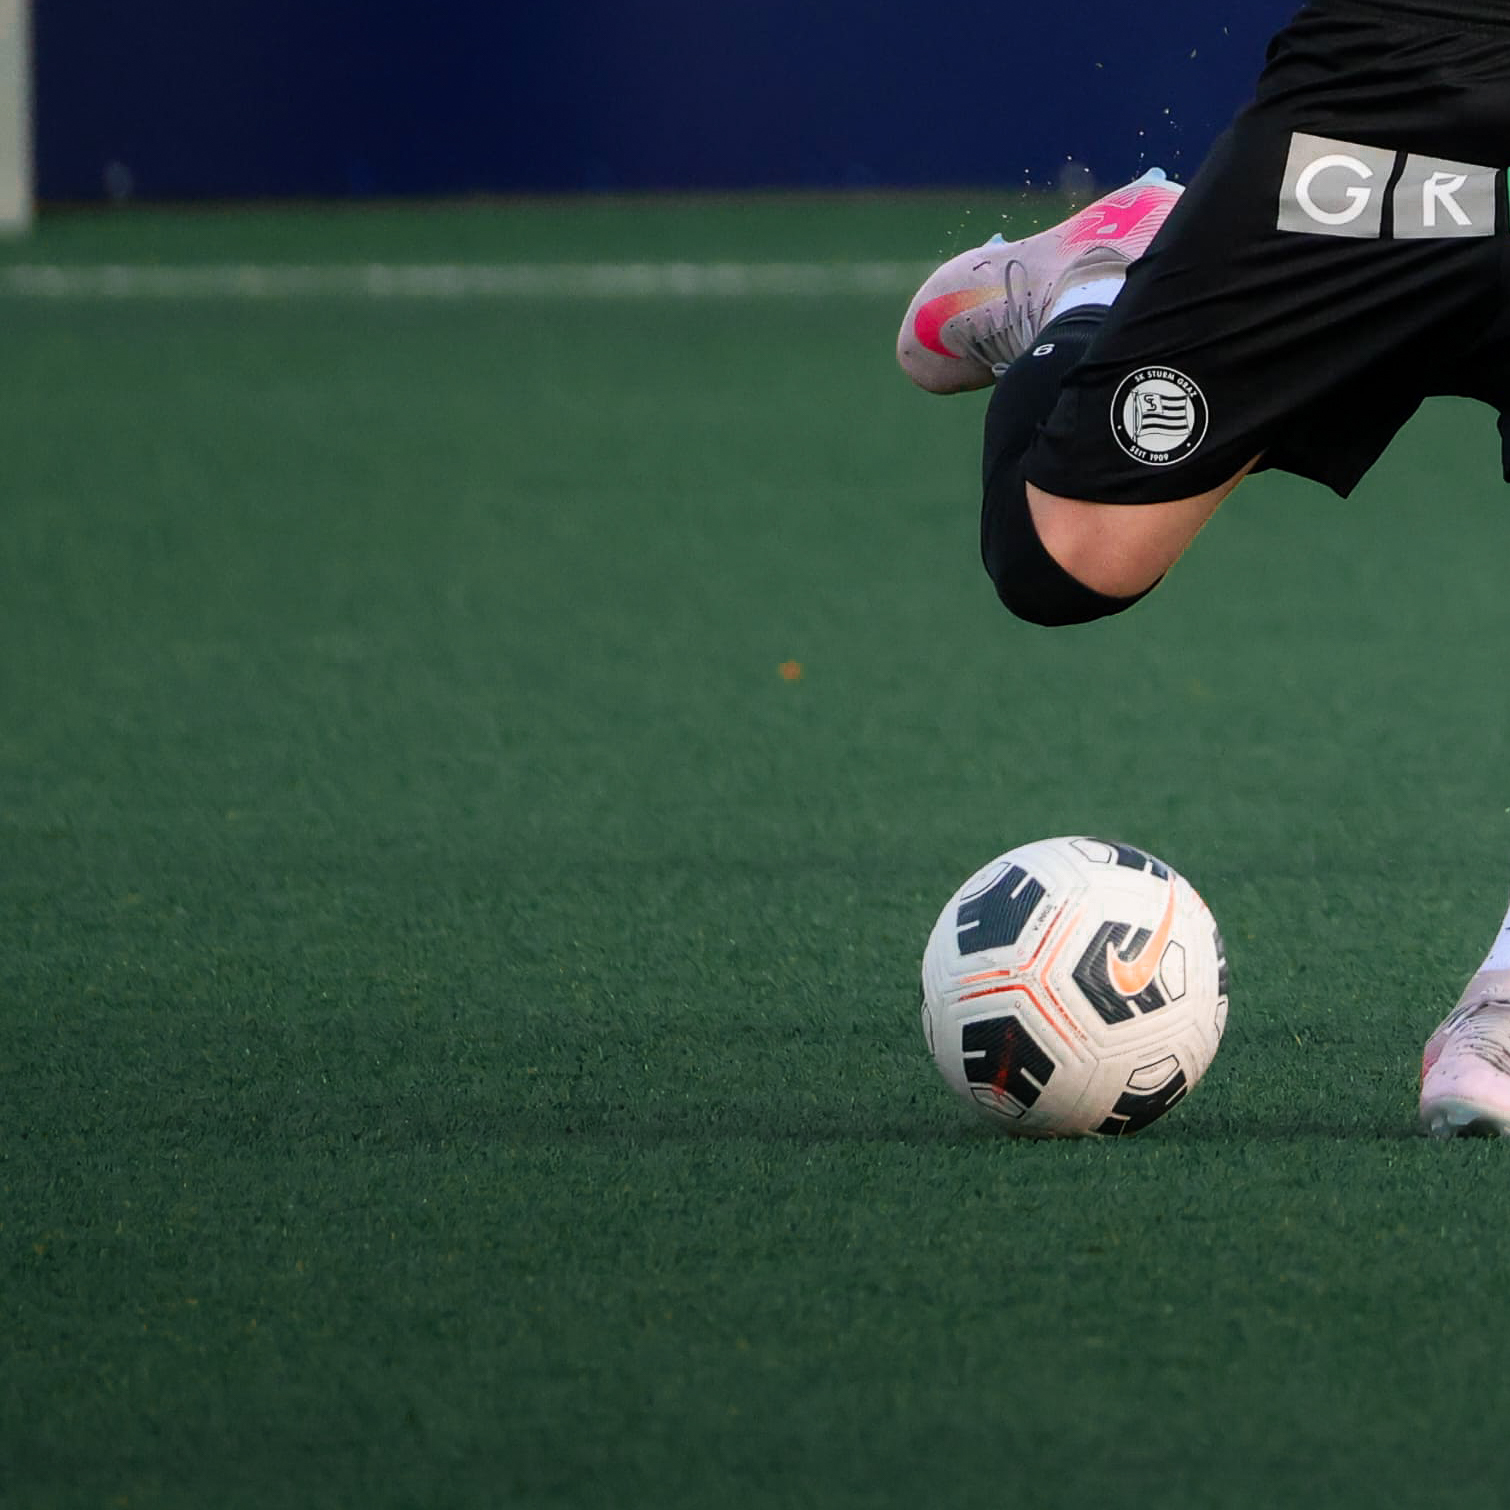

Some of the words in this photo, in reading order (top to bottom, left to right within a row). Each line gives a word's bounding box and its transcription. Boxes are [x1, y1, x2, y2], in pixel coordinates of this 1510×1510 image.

[1134, 373, 1146, 383] SK
[1147, 370, 1175, 381] STURM
[1176, 377, 1198, 399] GRAZ
[1129, 444, 1147, 458] SEIT
[1149, 453, 1169, 462] 1909
